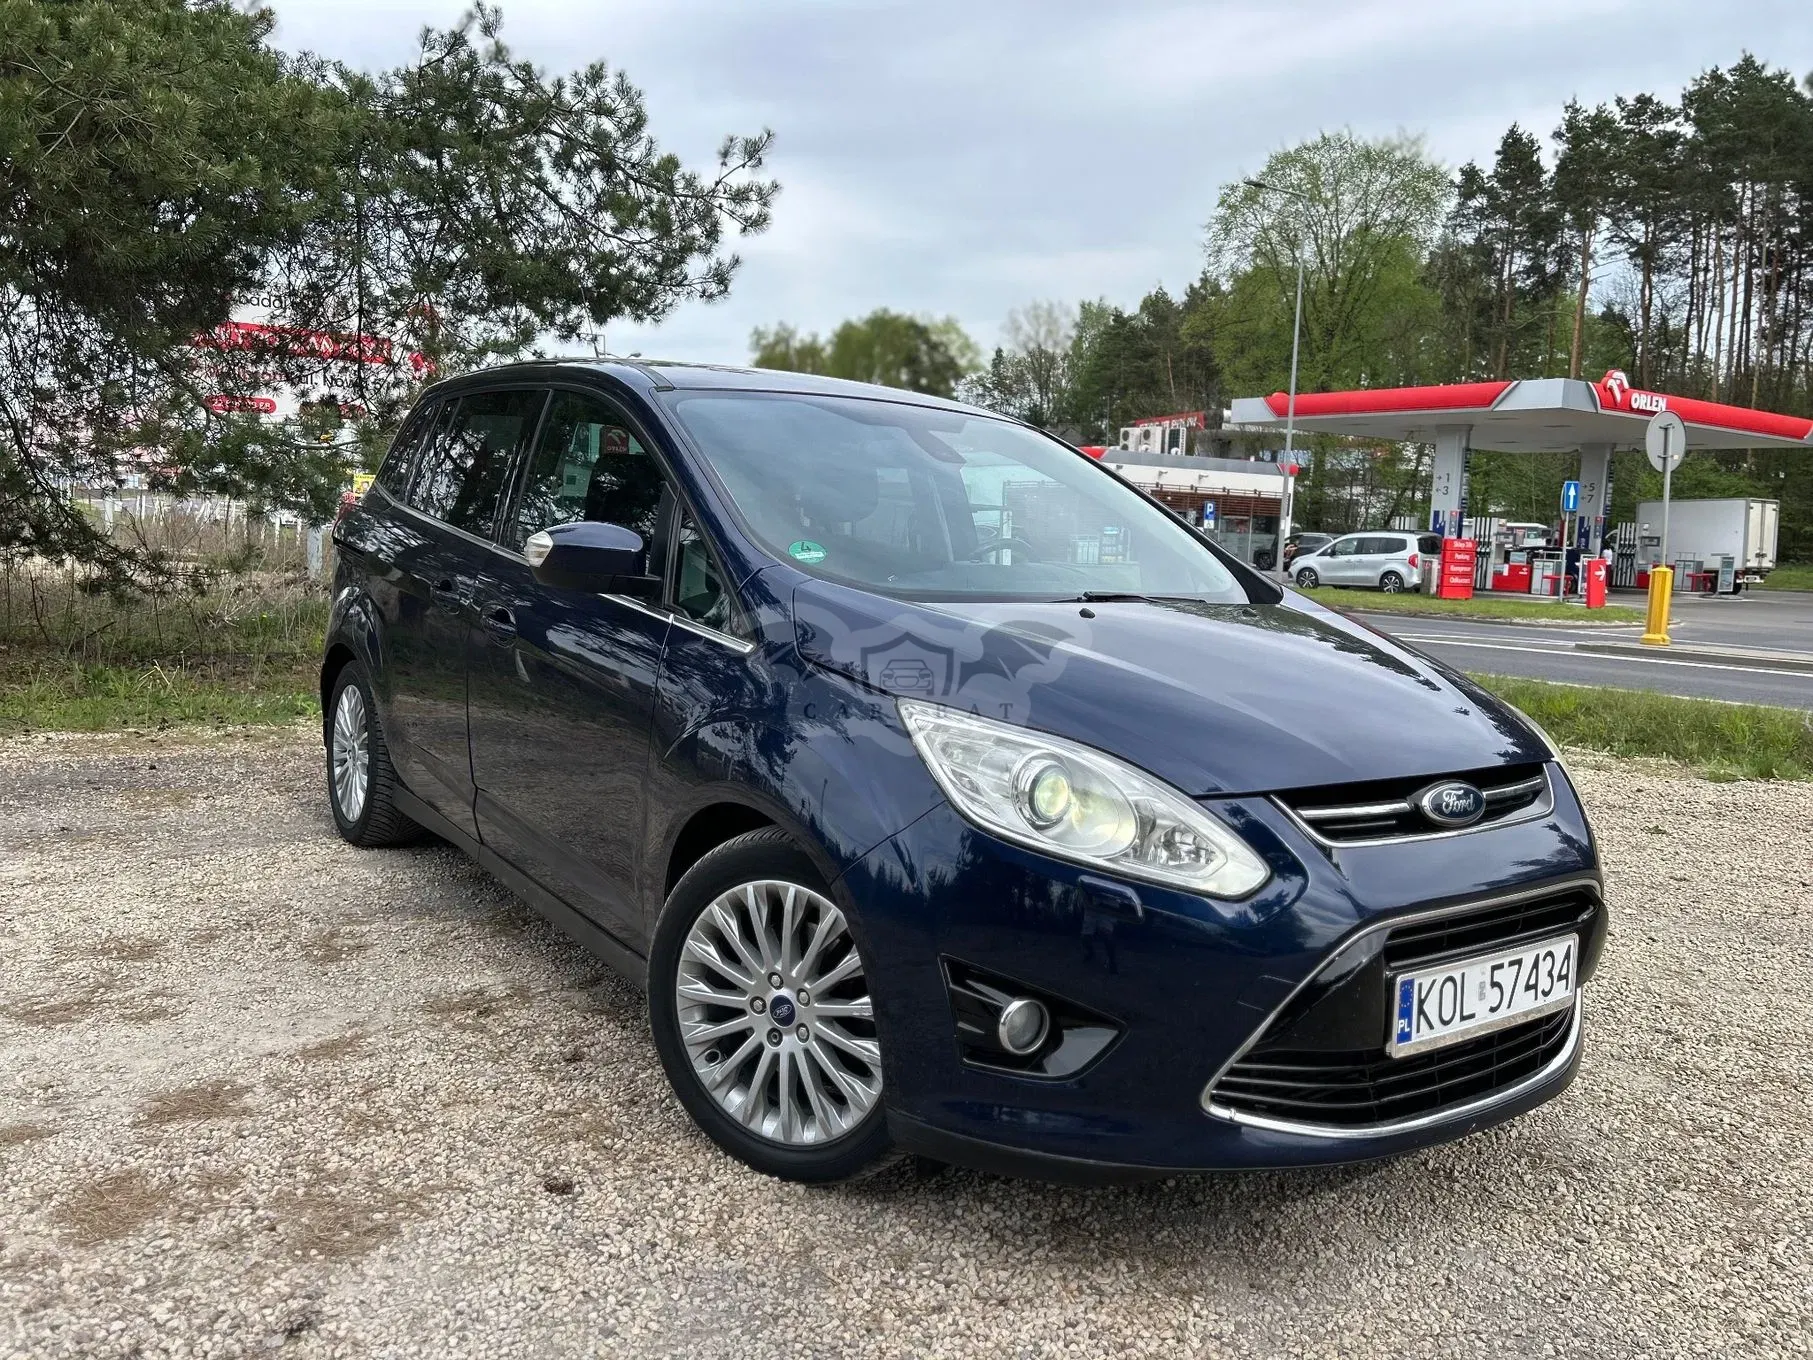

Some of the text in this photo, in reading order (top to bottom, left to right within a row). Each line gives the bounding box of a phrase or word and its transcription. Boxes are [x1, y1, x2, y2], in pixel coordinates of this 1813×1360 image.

[1631, 391, 1667, 411] ORLEN
[1446, 473, 1450, 482] 1
[1442, 486, 1449, 495] 3
[1589, 483, 1595, 491] 5
[1587, 495, 1595, 503] 7
[1206, 503, 1214, 515] P
[1442, 789, 1476, 815] Ford
[1416, 944, 1572, 1033] KOL 57434
[1397, 1020, 1410, 1034] PL
